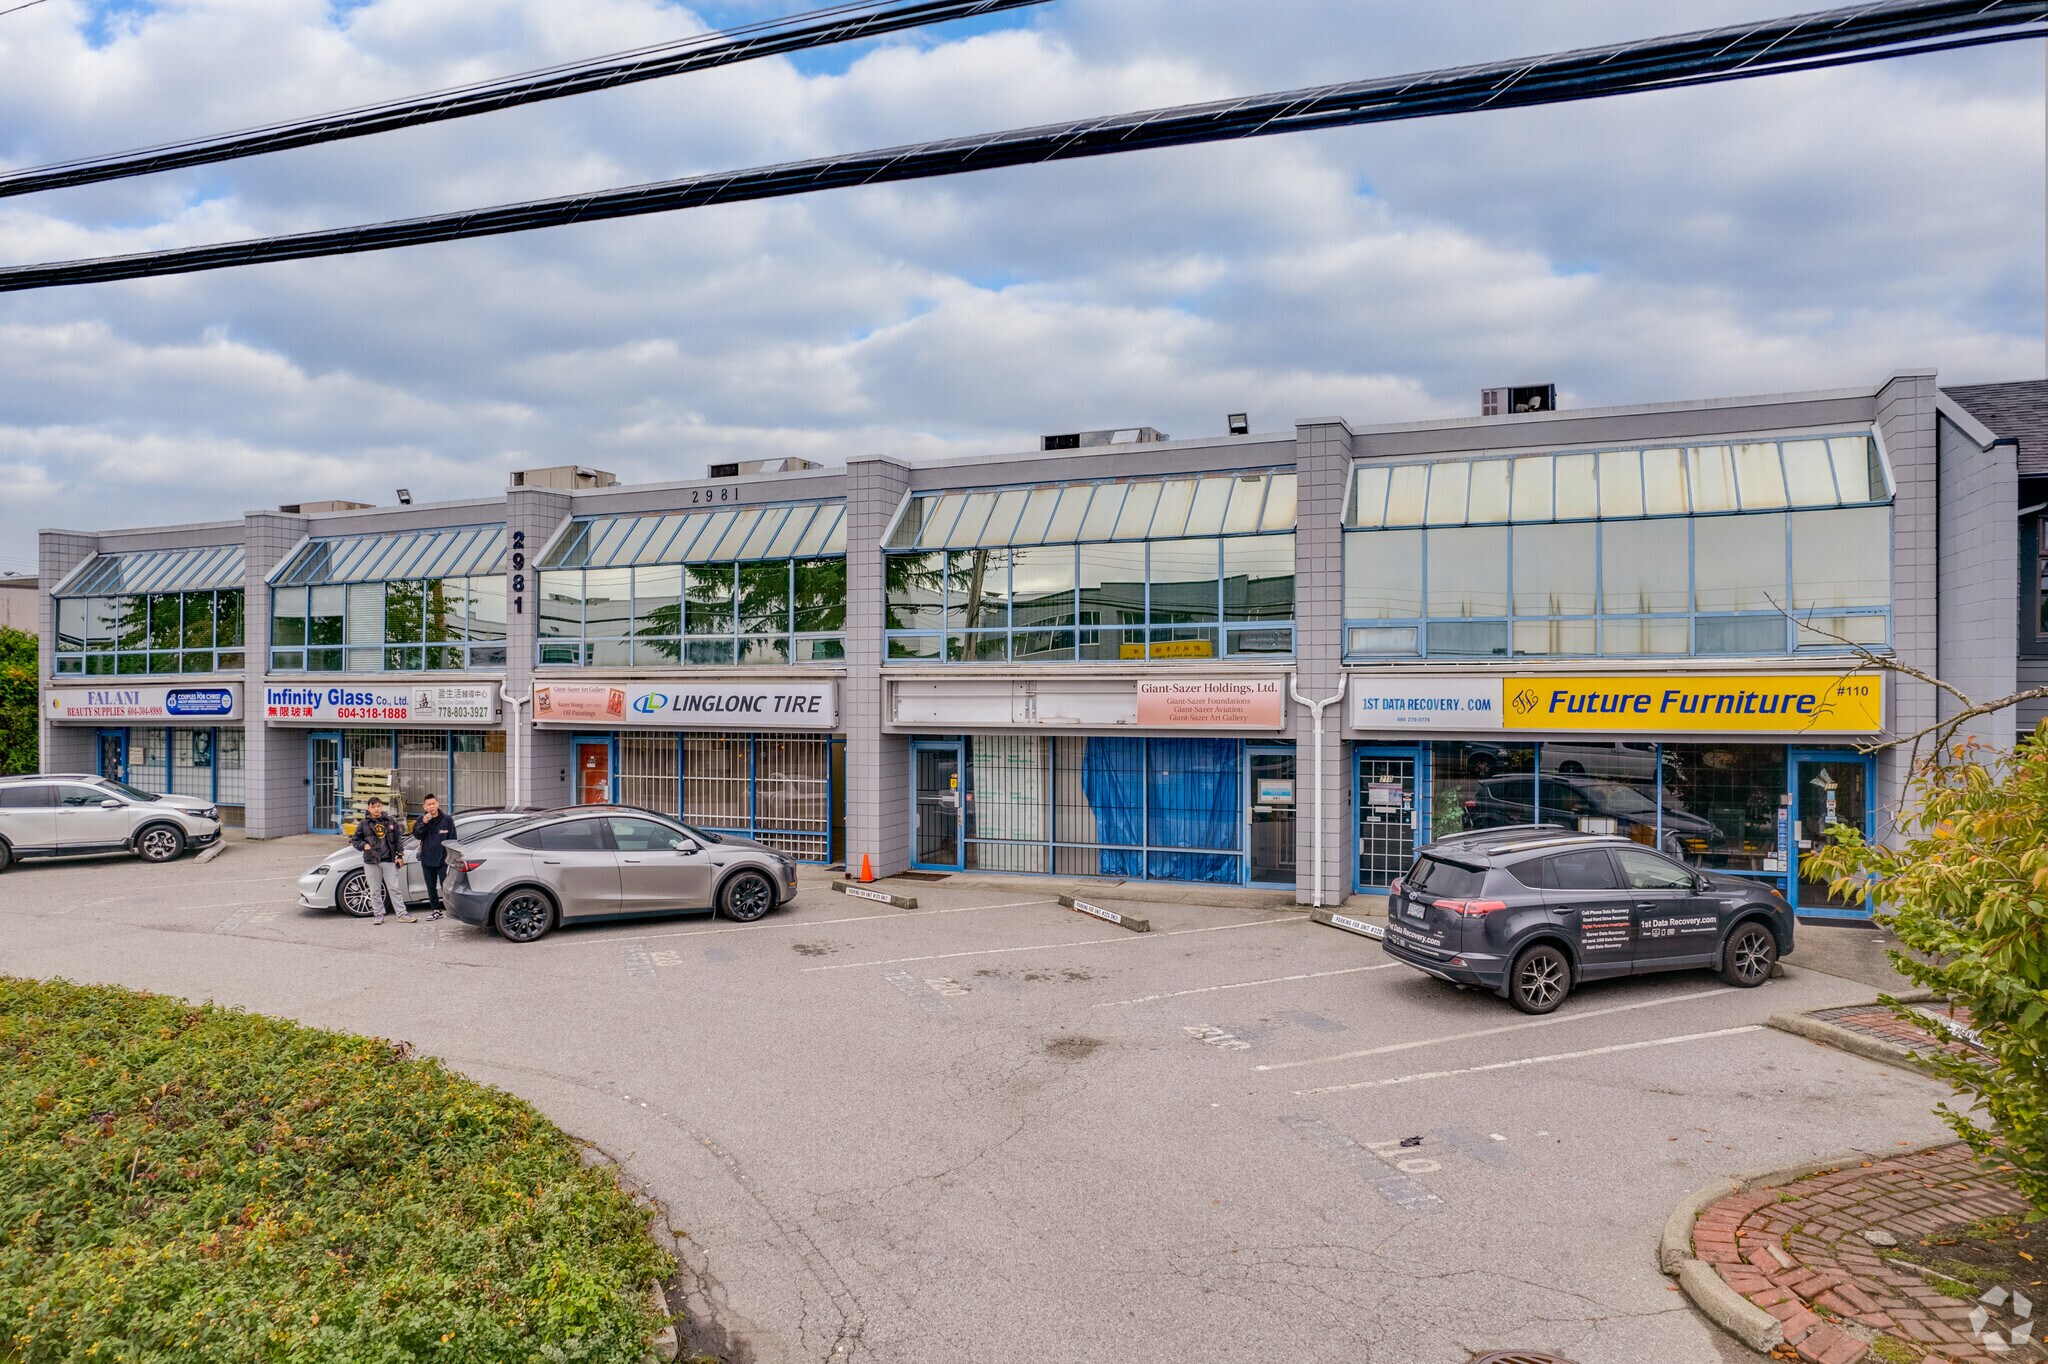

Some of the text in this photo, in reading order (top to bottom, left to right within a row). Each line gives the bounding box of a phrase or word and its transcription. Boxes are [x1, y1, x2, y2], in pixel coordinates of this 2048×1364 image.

[692, 488, 739, 503] 2981
[512, 531, 524, 614] 2981
[1141, 683, 1278, 695] Giant-Sazer Holdings, Ltd.
[1837, 686, 1869, 696] #110
[88, 690, 140, 705] FALANI
[267, 688, 409, 709] Infinity Glass Co., Ltd.
[1549, 690, 1816, 714] Future Furniture
[774, 695, 822, 713] TIRE
[1363, 698, 1380, 710] 1ST
[1382, 698, 1406, 710] DATA
[67, 708, 92, 716] BEAUTY
[94, 707, 124, 716] SUPPLIES
[268, 706, 313, 718] 無限玻璃
[338, 708, 407, 719] 604-318-1888
[438, 707, 488, 718] 778-803-3927
[1169, 714, 1208, 722] Giant-Sazer
[1223, 714, 1248, 723] Gallery
[1336, 916, 1352, 926] PARKING
[1360, 924, 1370, 932] UNIT
[1641, 916, 1716, 928] 1st Data Recovery.com
[1394, 924, 1403, 934] Data
[1402, 928, 1441, 946] Recovery.com
